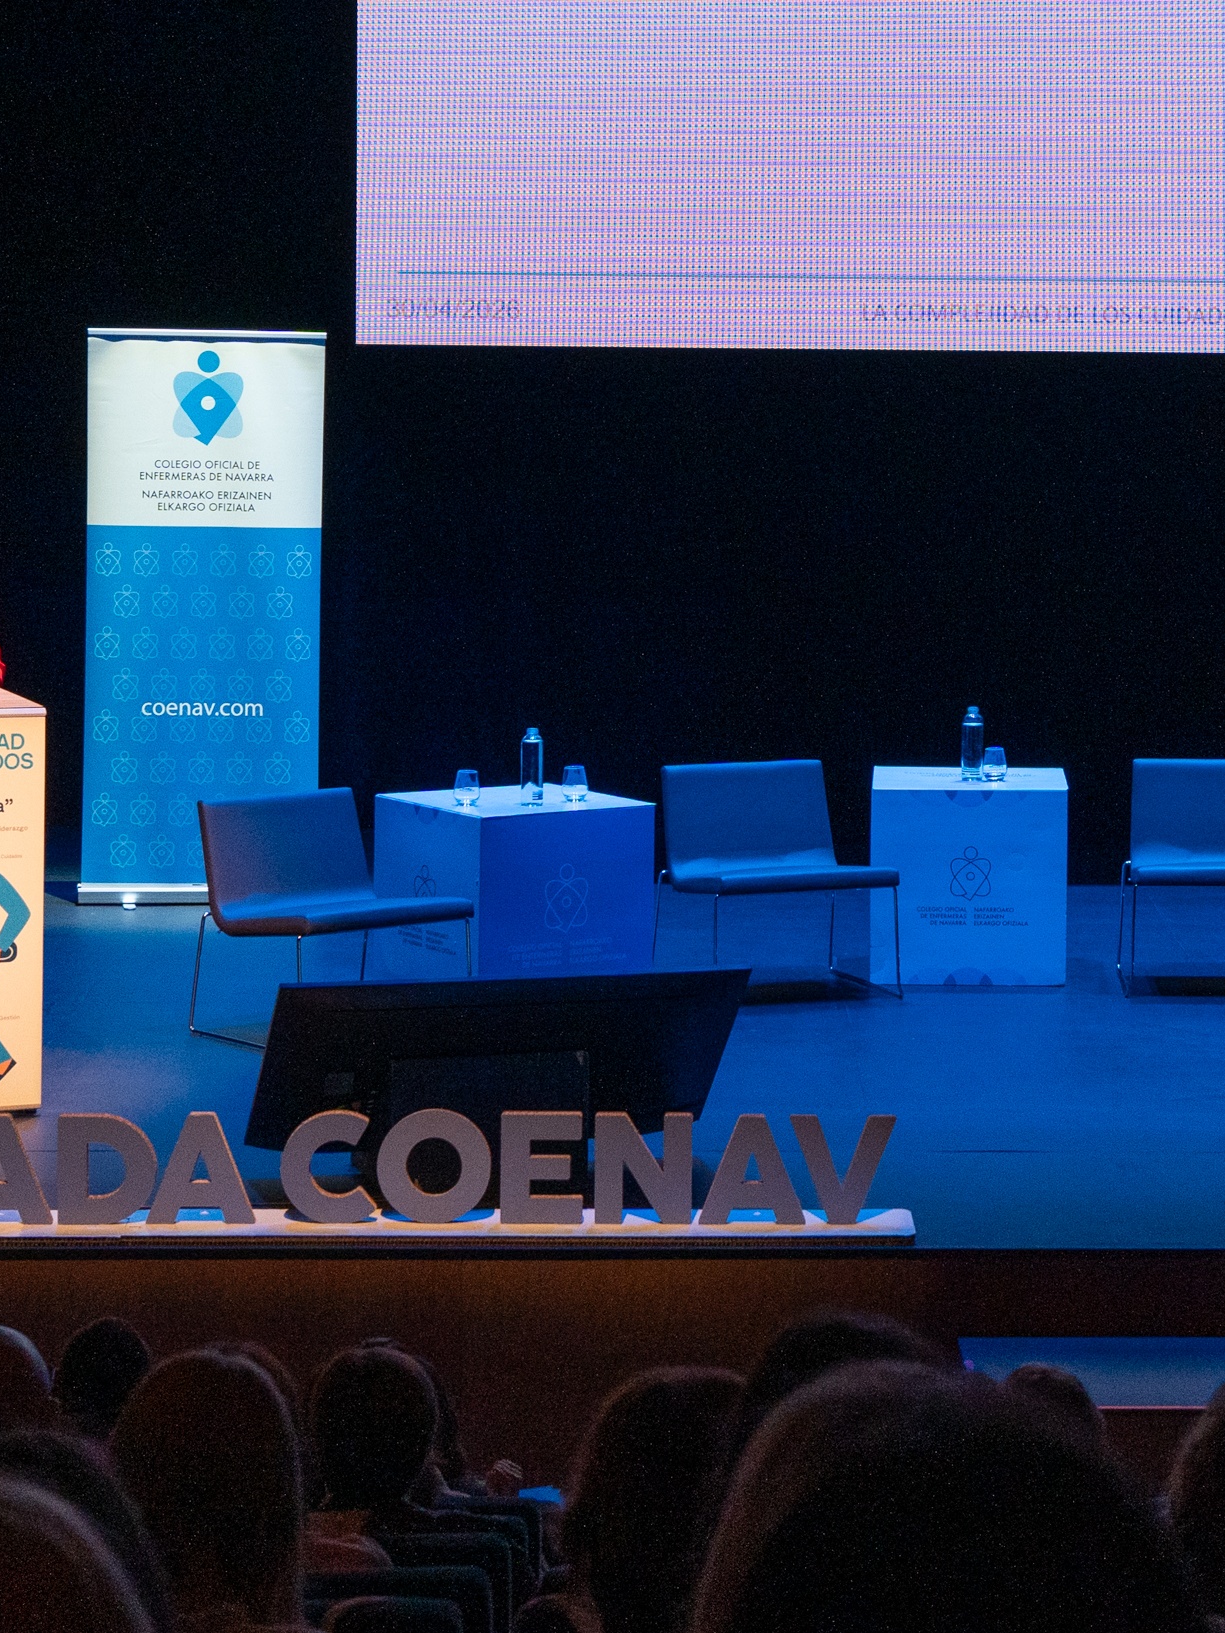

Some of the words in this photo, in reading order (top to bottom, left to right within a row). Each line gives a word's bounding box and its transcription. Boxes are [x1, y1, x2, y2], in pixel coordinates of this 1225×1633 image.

[386, 296, 521, 319] 30/04/2026
[861, 303, 888, 324] LA
[1056, 304, 1084, 324] DE
[1093, 304, 1132, 325] LOS
[154, 460, 201, 469] COLEGIO
[205, 460, 244, 470] OFICIAL
[248, 461, 260, 470] DE
[140, 472, 206, 481] ENFERMERAS
[210, 472, 222, 481] DE
[226, 473, 274, 482] NAVARRA
[142, 490, 214, 500] NAFARROAKO
[218, 491, 272, 500] ERIZAINEN
[158, 502, 206, 512] ELKARGO
[209, 503, 255, 512] OFIZIALA
[142, 702, 264, 716] coenav.com
[279, 1108, 897, 1225] COENAV
